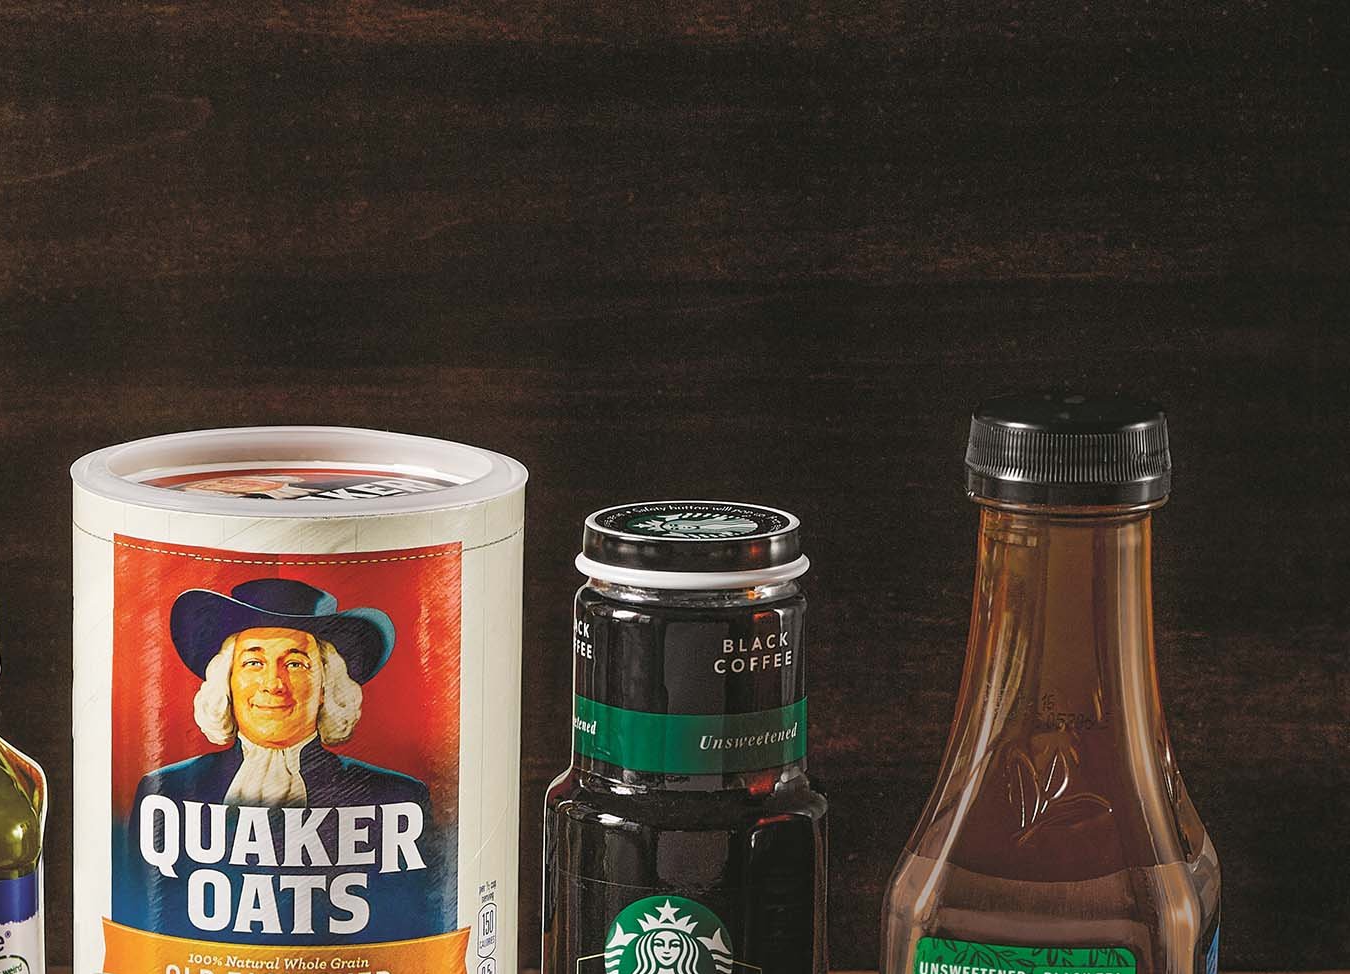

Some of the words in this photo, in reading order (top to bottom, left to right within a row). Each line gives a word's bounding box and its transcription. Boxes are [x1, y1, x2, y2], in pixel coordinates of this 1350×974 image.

[723, 631, 789, 654] BLACK
[713, 650, 793, 675] COFFEE
[699, 721, 798, 751] Unsweetened
[138, 793, 428, 878] QUAKER
[186, 867, 371, 936] OATS
[225, 955, 280, 970] Natural
[284, 957, 327, 970] Whole
[330, 957, 370, 969] Grain
